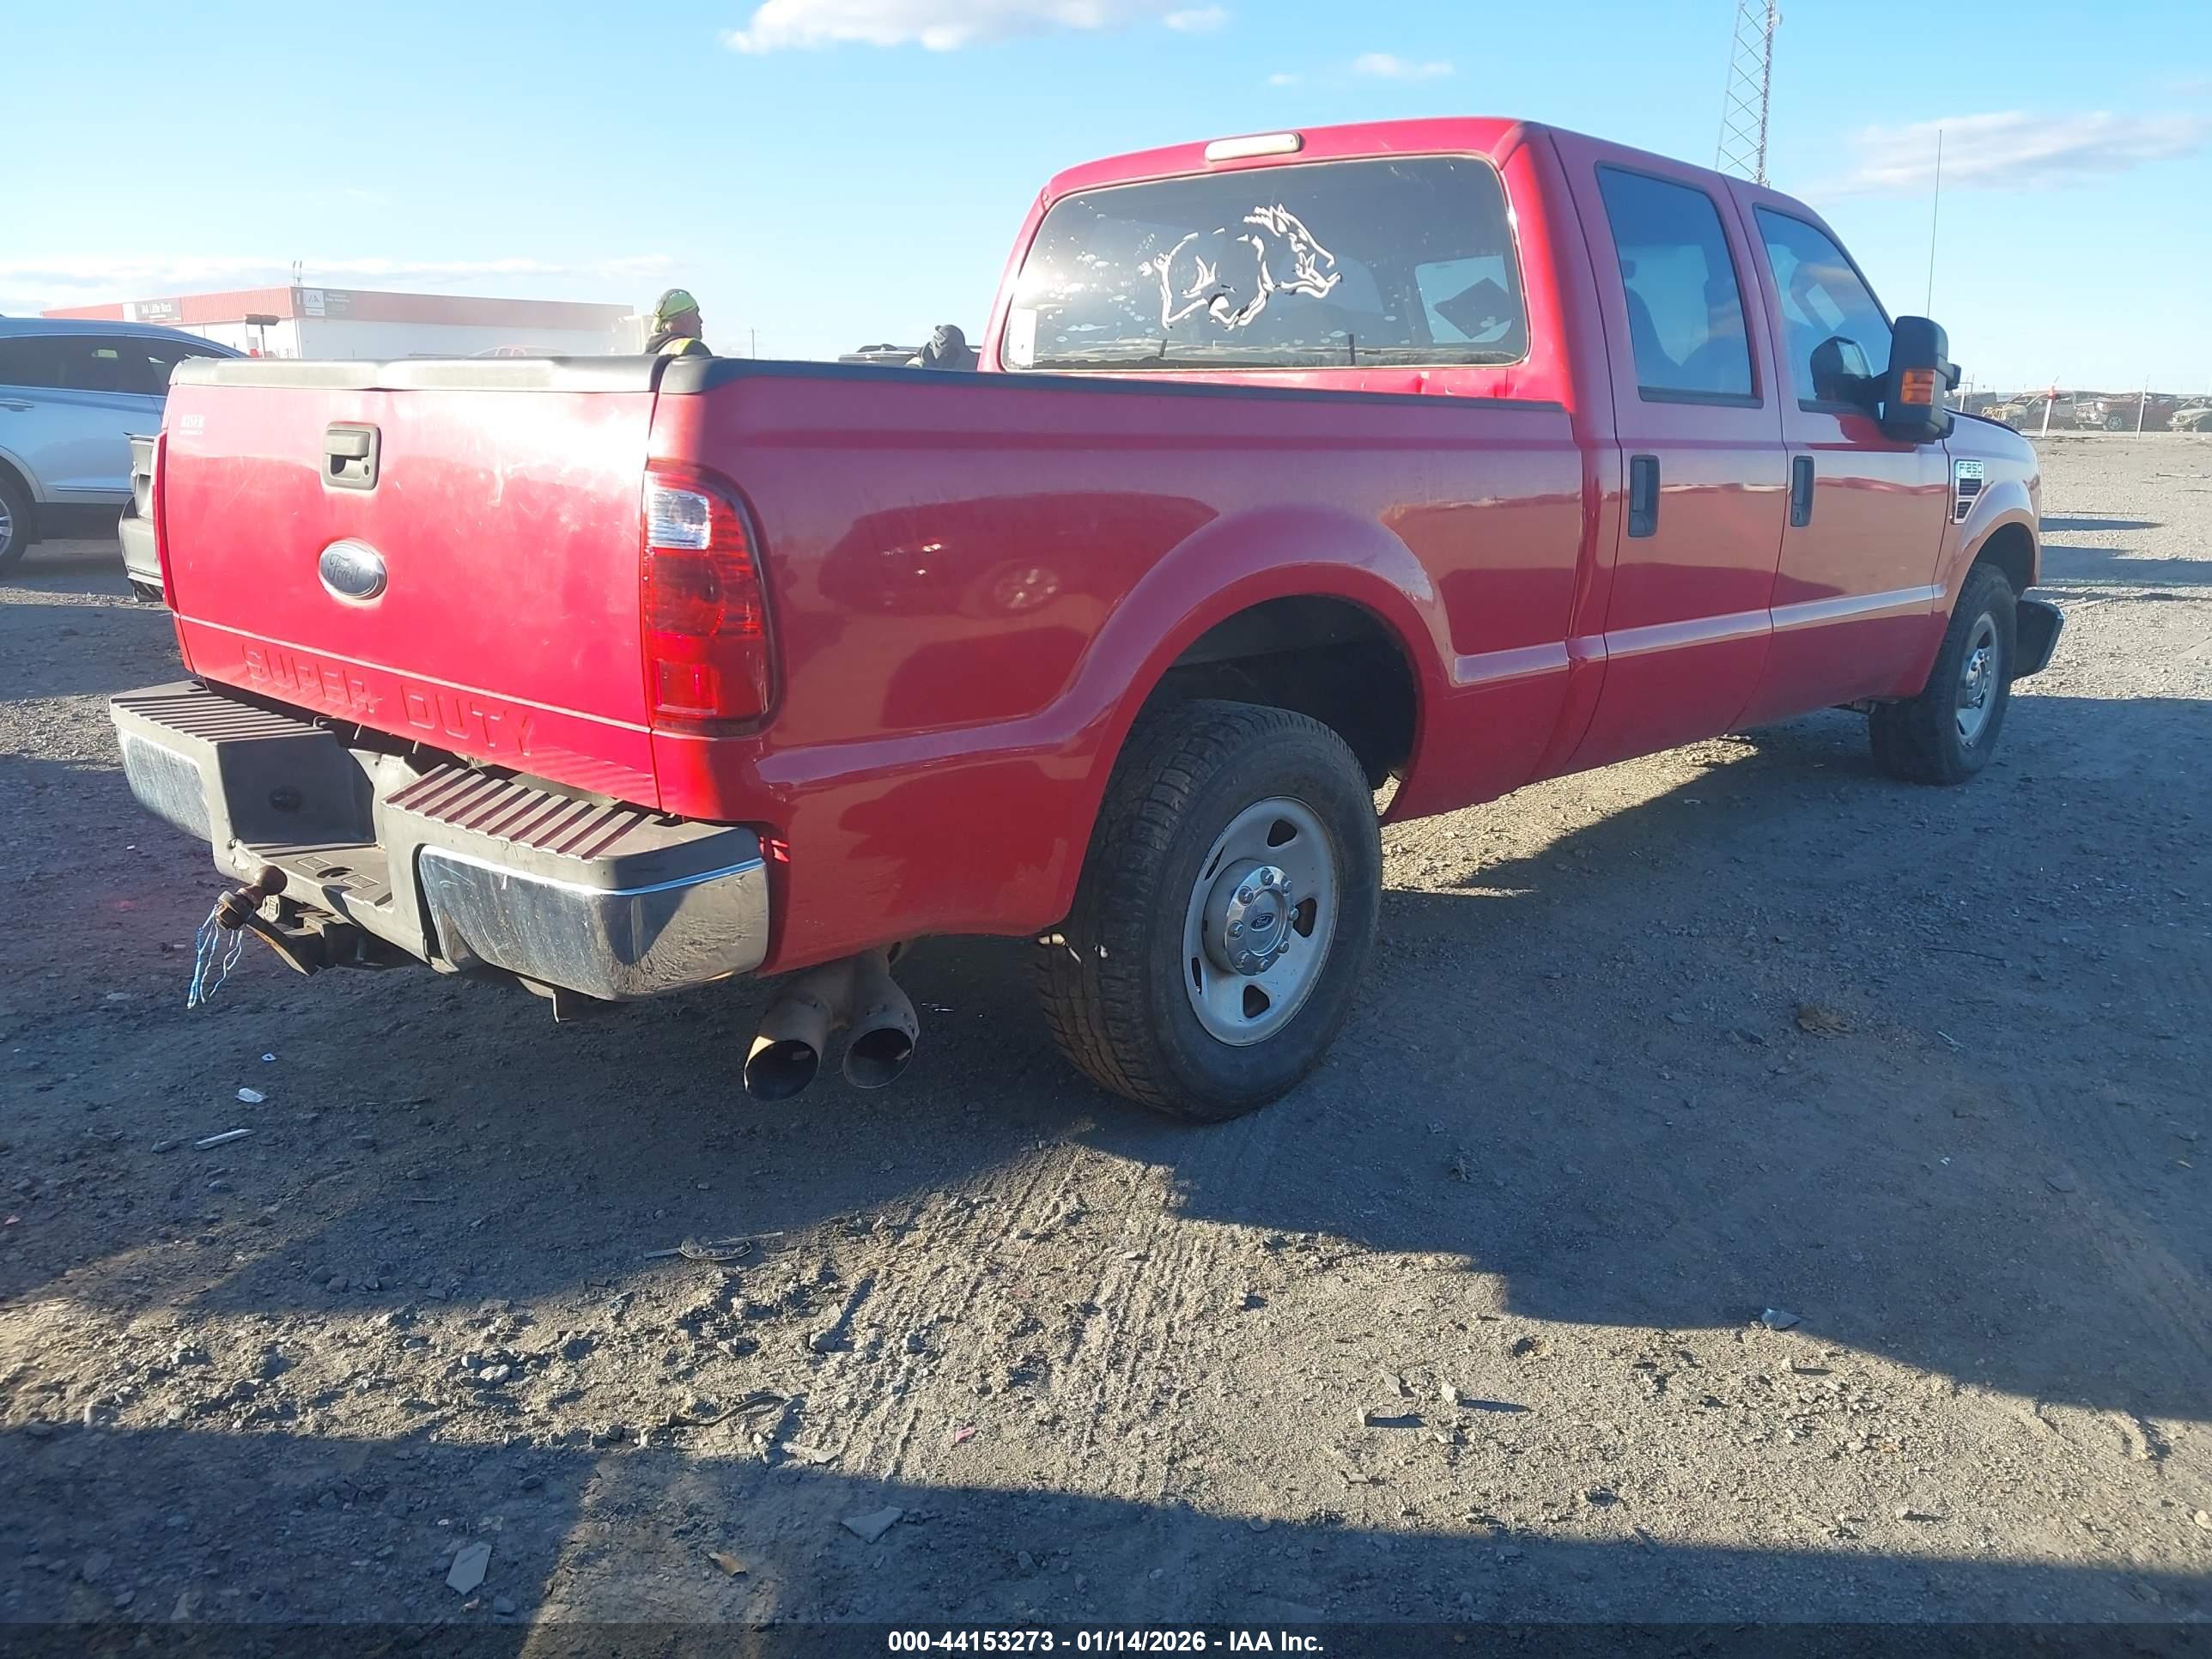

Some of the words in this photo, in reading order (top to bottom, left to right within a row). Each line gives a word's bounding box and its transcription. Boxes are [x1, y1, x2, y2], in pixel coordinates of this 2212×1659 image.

[149, 302, 161, 314] Little
[1959, 463, 1983, 473] F-250
[327, 553, 361, 586] Ford
[242, 645, 376, 714] SUPER
[400, 684, 534, 757] DUTY
